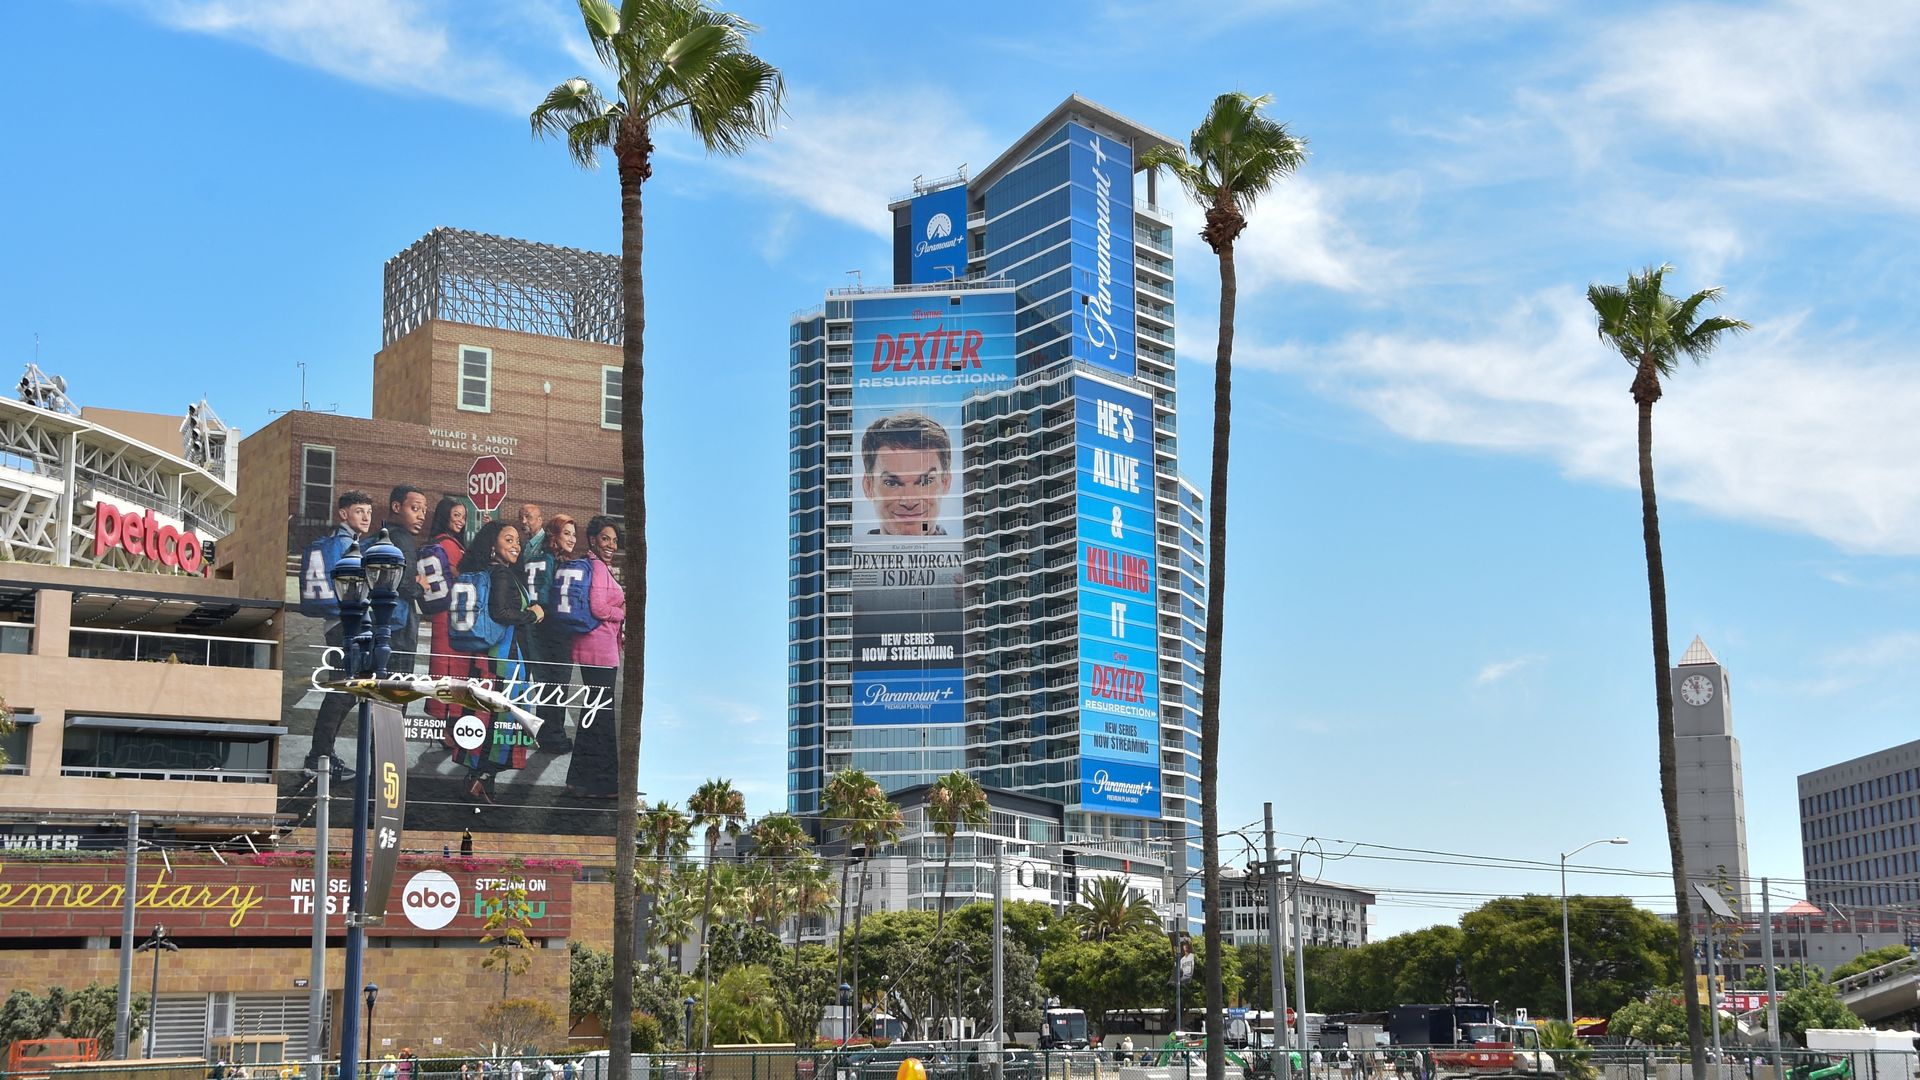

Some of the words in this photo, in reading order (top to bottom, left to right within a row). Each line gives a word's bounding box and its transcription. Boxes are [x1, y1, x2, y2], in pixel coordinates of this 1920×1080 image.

[915, 235, 964, 257] Paramount+
[1084, 136, 1118, 360] Paramount+
[872, 323, 983, 372] DEXTER
[859, 373, 996, 388] RESURRECTION
[1097, 398, 1134, 443] HE'S
[428, 428, 467, 440] WILLARD
[486, 436, 518, 446] ABBOTT
[432, 439, 467, 450] PUBLIC
[472, 444, 514, 456] SCHOOL
[1093, 447, 1139, 493] ALIVE
[469, 471, 505, 495] STOP
[1111, 505, 1123, 538] &
[95, 501, 202, 573] petco
[853, 554, 904, 569] DEXTER
[908, 554, 962, 568] MORGAN
[1087, 546, 1149, 594] KILLING
[882, 570, 895, 586] IS
[899, 569, 935, 586] DEAD
[1111, 601, 1126, 638] IT
[881, 634, 902, 646] NEW
[904, 633, 935, 645] SERIES
[862, 647, 887, 662] NOW
[891, 646, 954, 660] STREAMING
[1091, 662, 1145, 704] DEXTER
[862, 683, 954, 706] Paramount+
[1085, 700, 1150, 717] RESURRECTION
[414, 718, 447, 728] SEASON
[456, 725, 484, 738] abc
[1104, 722, 1118, 734] NEW
[1118, 724, 1137, 736] SERIES
[421, 728, 445, 740] FALL
[493, 730, 534, 746] hulu
[1093, 734, 1109, 749] NOW
[1111, 737, 1149, 754] STREAMING
[1092, 769, 1152, 796] Paramount+
[0, 834, 79, 851] WATER
[291, 879, 315, 892] NE
[528, 879, 546, 892] ON
[291, 896, 337, 914] THS
[407, 887, 457, 908] abc
